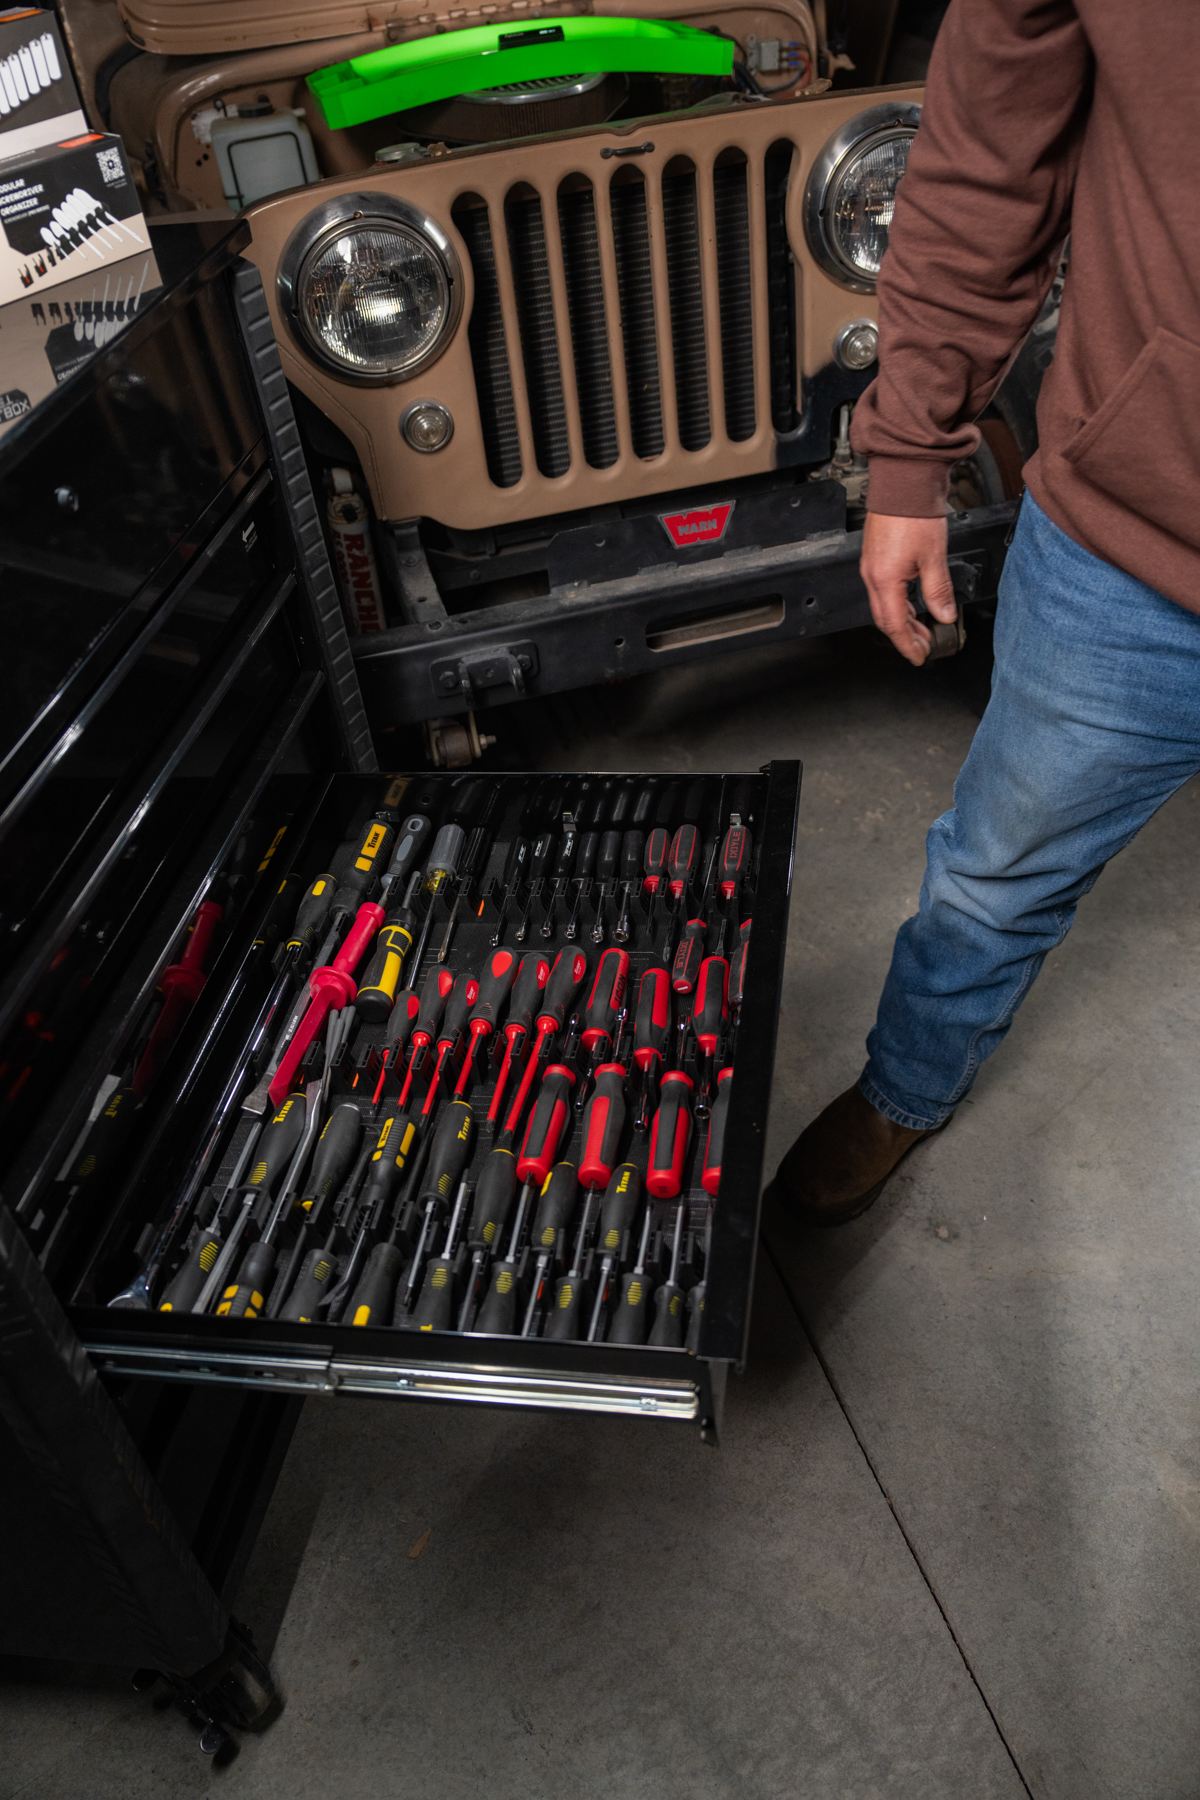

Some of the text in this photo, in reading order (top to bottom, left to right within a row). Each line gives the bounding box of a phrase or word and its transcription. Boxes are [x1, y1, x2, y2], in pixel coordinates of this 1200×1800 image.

[0, 178, 25, 194] ODULAR
[0, 197, 39, 217] ORGANIZER
[677, 518, 718, 537] WARN
[729, 831, 741, 859] DOYLE
[676, 941, 689, 969] DOYLE
[614, 973, 627, 1005] ICON
